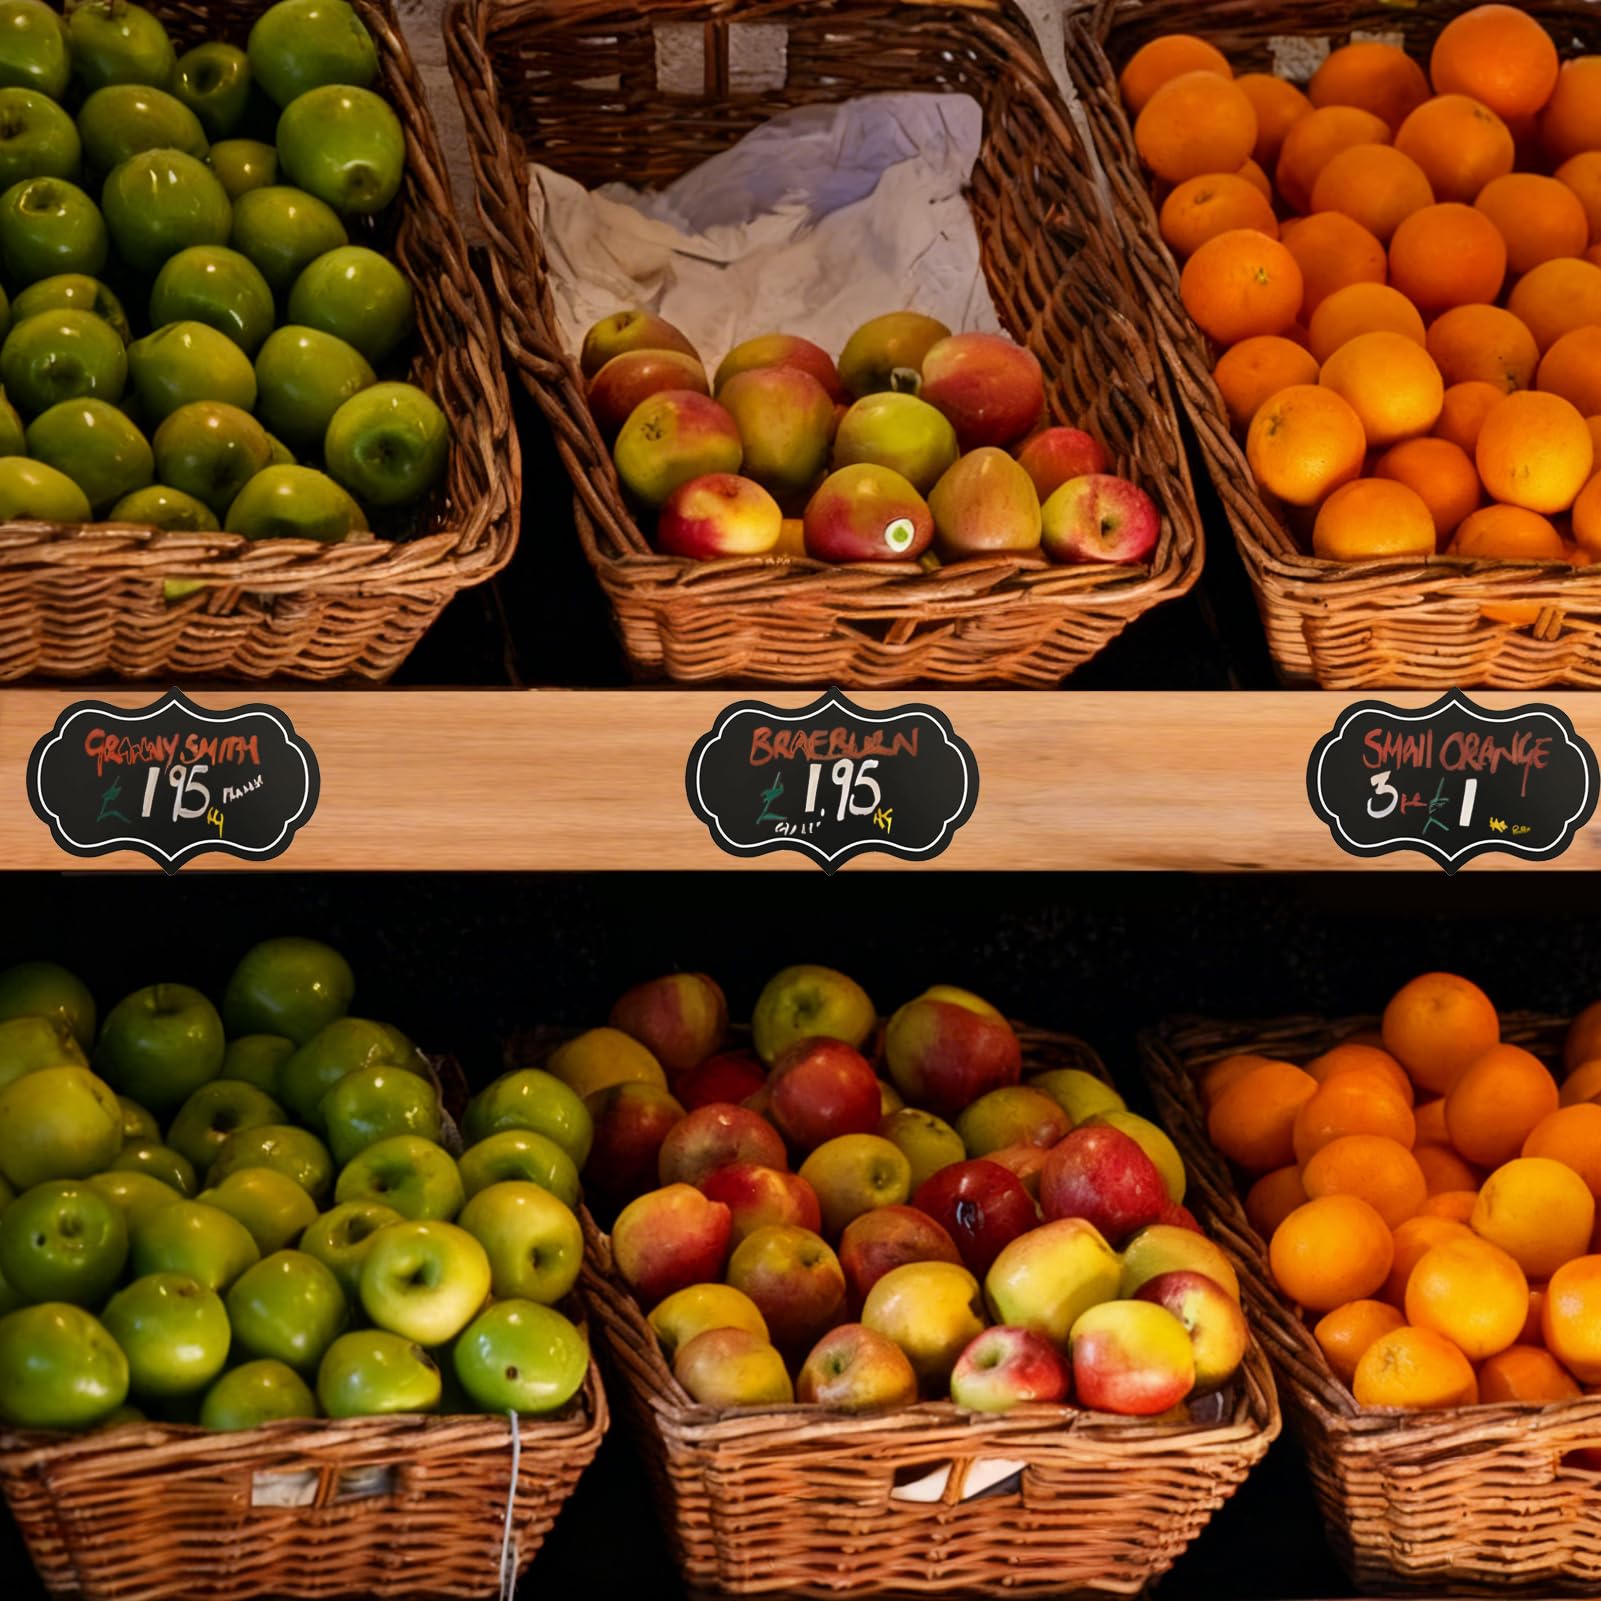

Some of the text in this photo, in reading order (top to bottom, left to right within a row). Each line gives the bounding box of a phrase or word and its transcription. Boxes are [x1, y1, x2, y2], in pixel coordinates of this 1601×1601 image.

[179, 733, 261, 767] SMITH
[750, 726, 919, 767] BRAEBURN
[1439, 730, 1553, 798] ORANGE
[804, 758, 882, 822] 1.95
[1366, 770, 1399, 819] 3
[1458, 778, 1478, 827] 1
